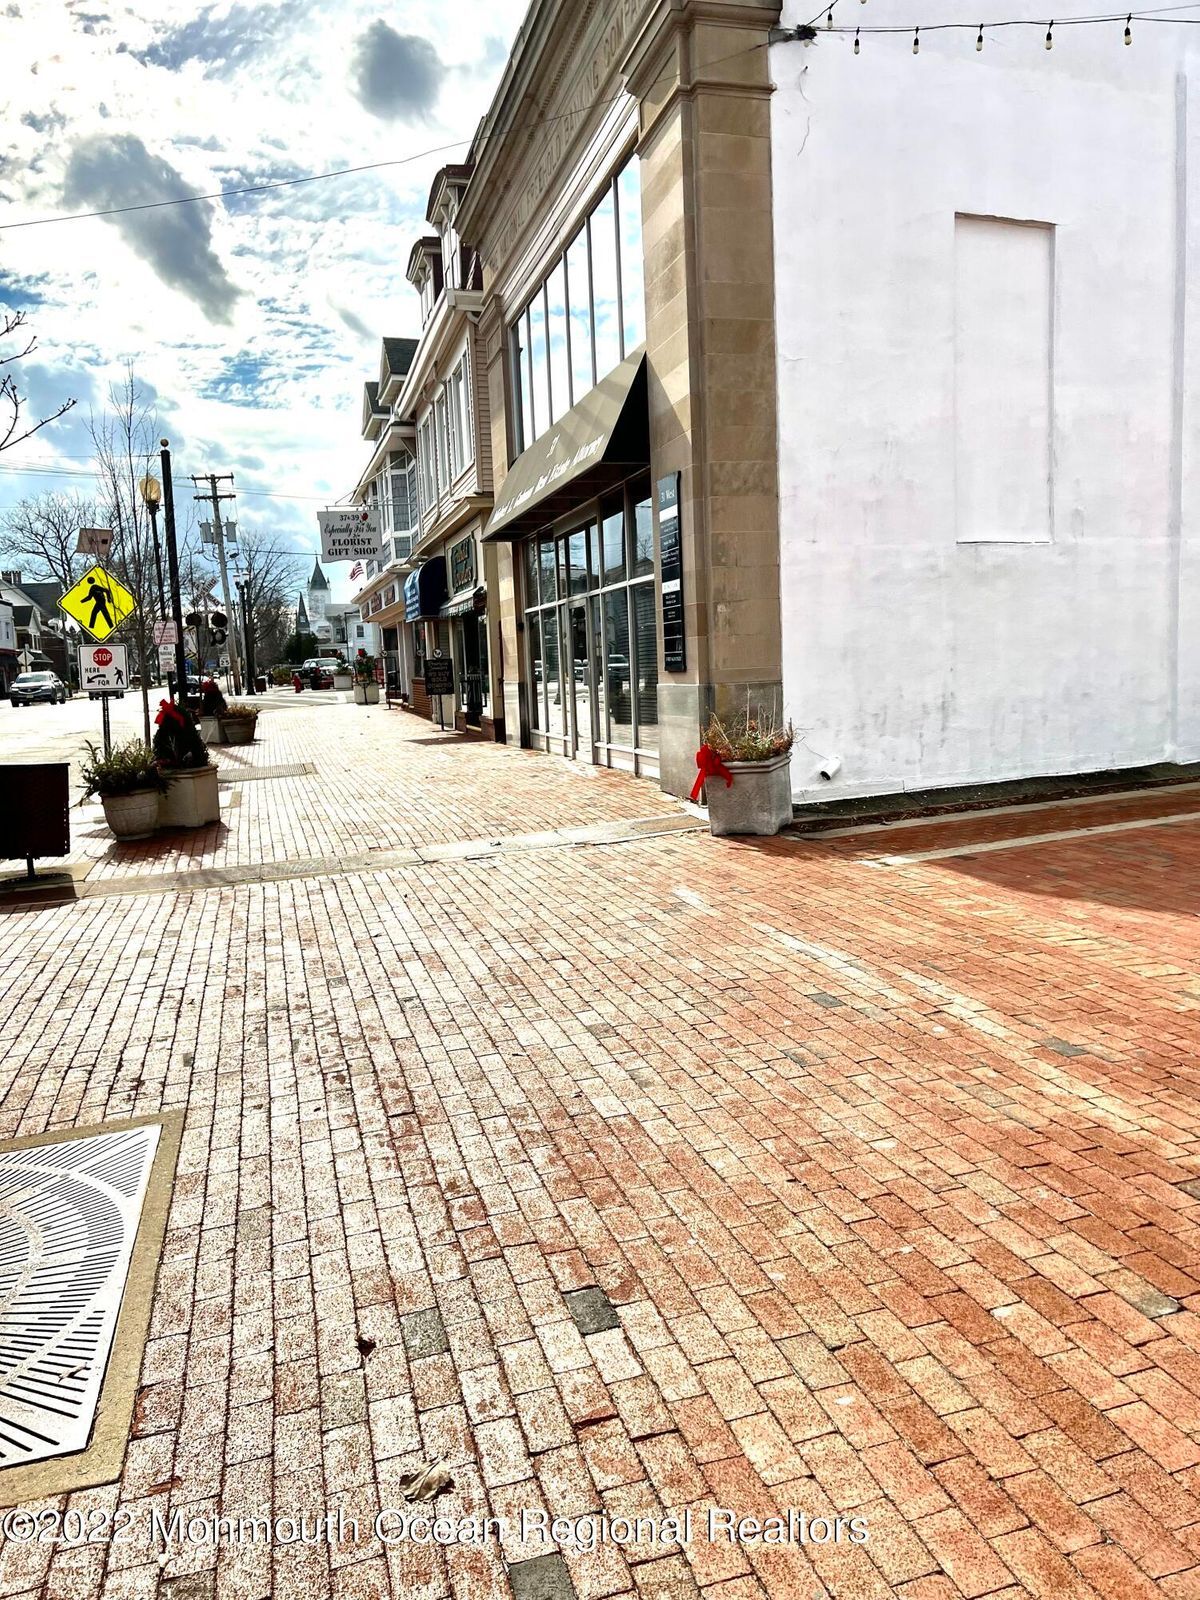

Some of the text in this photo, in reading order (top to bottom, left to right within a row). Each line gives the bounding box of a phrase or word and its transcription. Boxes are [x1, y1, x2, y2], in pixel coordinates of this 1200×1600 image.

[527, 134, 561, 213] FREEHOLD
[564, 61, 599, 146] BANKING
[545, 456, 571, 486] Estate
[324, 523, 353, 538] Especially
[365, 522, 377, 533] You
[332, 537, 372, 546] FLORIST
[328, 547, 378, 556] GIFT SHOP
[93, 653, 112, 662] STOP
[97, 679, 111, 687] FOR
